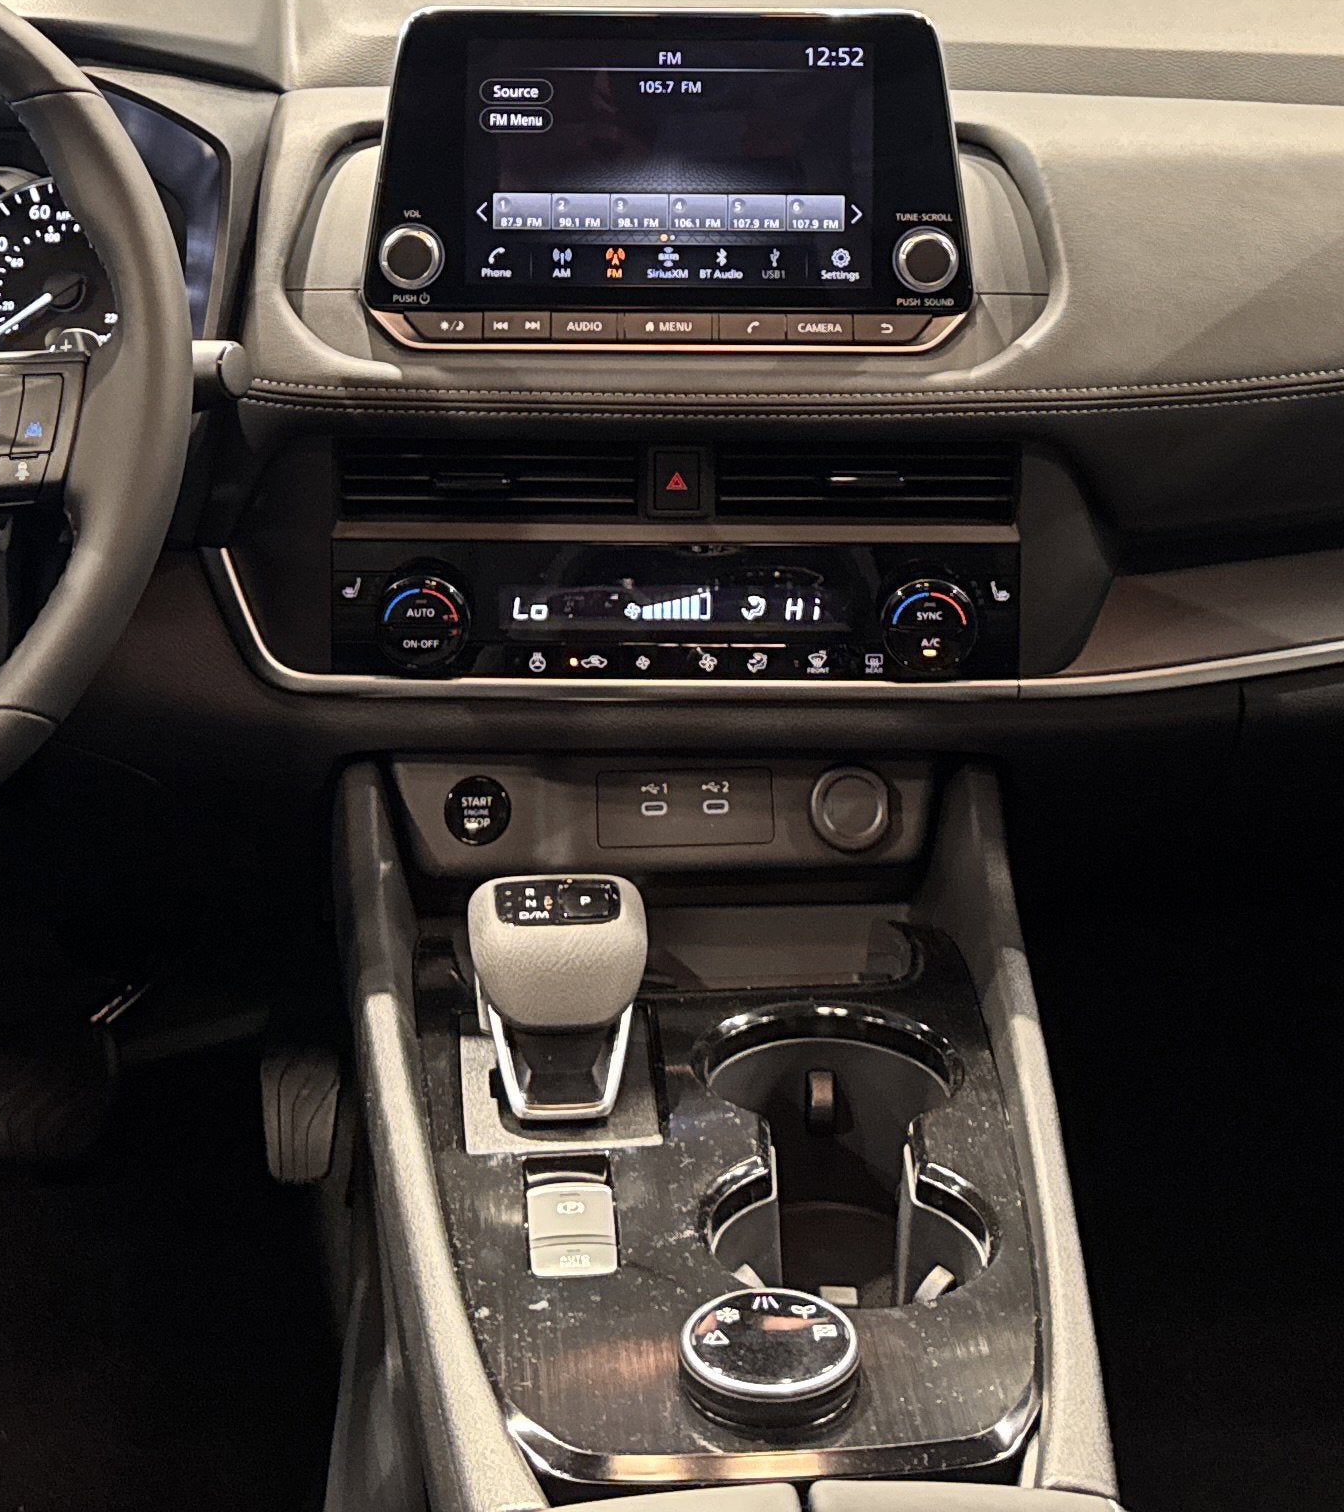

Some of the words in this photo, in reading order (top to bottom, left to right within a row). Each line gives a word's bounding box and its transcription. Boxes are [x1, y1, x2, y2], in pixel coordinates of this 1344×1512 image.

[658, 50, 682, 65] FM
[805, 46, 864, 67] 12:52
[493, 85, 539, 98] Source
[639, 81, 674, 94] 105.7
[681, 81, 702, 94] FM
[489, 113, 507, 126] FM
[510, 113, 543, 126] Menu
[500, 199, 506, 210] 1
[558, 200, 566, 210] 2
[616, 200, 624, 210] 3
[674, 201, 683, 210] 4
[734, 201, 742, 211] 5
[792, 201, 800, 212] 6
[29, 204, 51, 220] 60
[56, 211, 74, 220] MP
[403, 209, 422, 219] VOL
[501, 217, 523, 227] 87.9
[526, 217, 542, 227] FM
[559, 217, 580, 227] 90.1
[585, 217, 600, 227] FM
[617, 218, 639, 228] 98.1
[644, 218, 659, 228] FM
[674, 218, 700, 228] 106.1
[706, 218, 721, 228] FM
[733, 218, 760, 229] 107.9
[764, 218, 780, 229] FM
[792, 219, 819, 229] 107.9
[823, 219, 838, 229] FM
[481, 267, 513, 278] Phone
[552, 268, 571, 278] AM
[606, 268, 623, 278] FM
[646, 268, 689, 279] SiriusXM
[699, 269, 712, 279] BT
[713, 269, 744, 279] Audio
[761, 269, 786, 279] USB1
[820, 269, 860, 282] Settings
[392, 294, 417, 303] PUSH
[896, 297, 921, 306] PUSH
[924, 297, 954, 306] SOUND
[566, 321, 603, 331] AUDIO
[659, 321, 693, 332] MENU
[797, 322, 842, 333] CAMERA
[406, 607, 435, 618] AUTO
[512, 596, 549, 620] Lo
[785, 596, 821, 621] Hi
[916, 610, 943, 621] SYNC
[920, 637, 941, 648] A/C
[806, 667, 830, 675] FRONT
[864, 667, 884, 675] REAR
[662, 782, 668, 794] 1
[722, 780, 729, 793] 2
[461, 796, 493, 807] START
[463, 808, 489, 817] ENGINE
[463, 817, 491, 829] STOP
[524, 887, 535, 897] R
[525, 898, 537, 908] N
[579, 894, 592, 906] P
[518, 910, 550, 920] D/M
